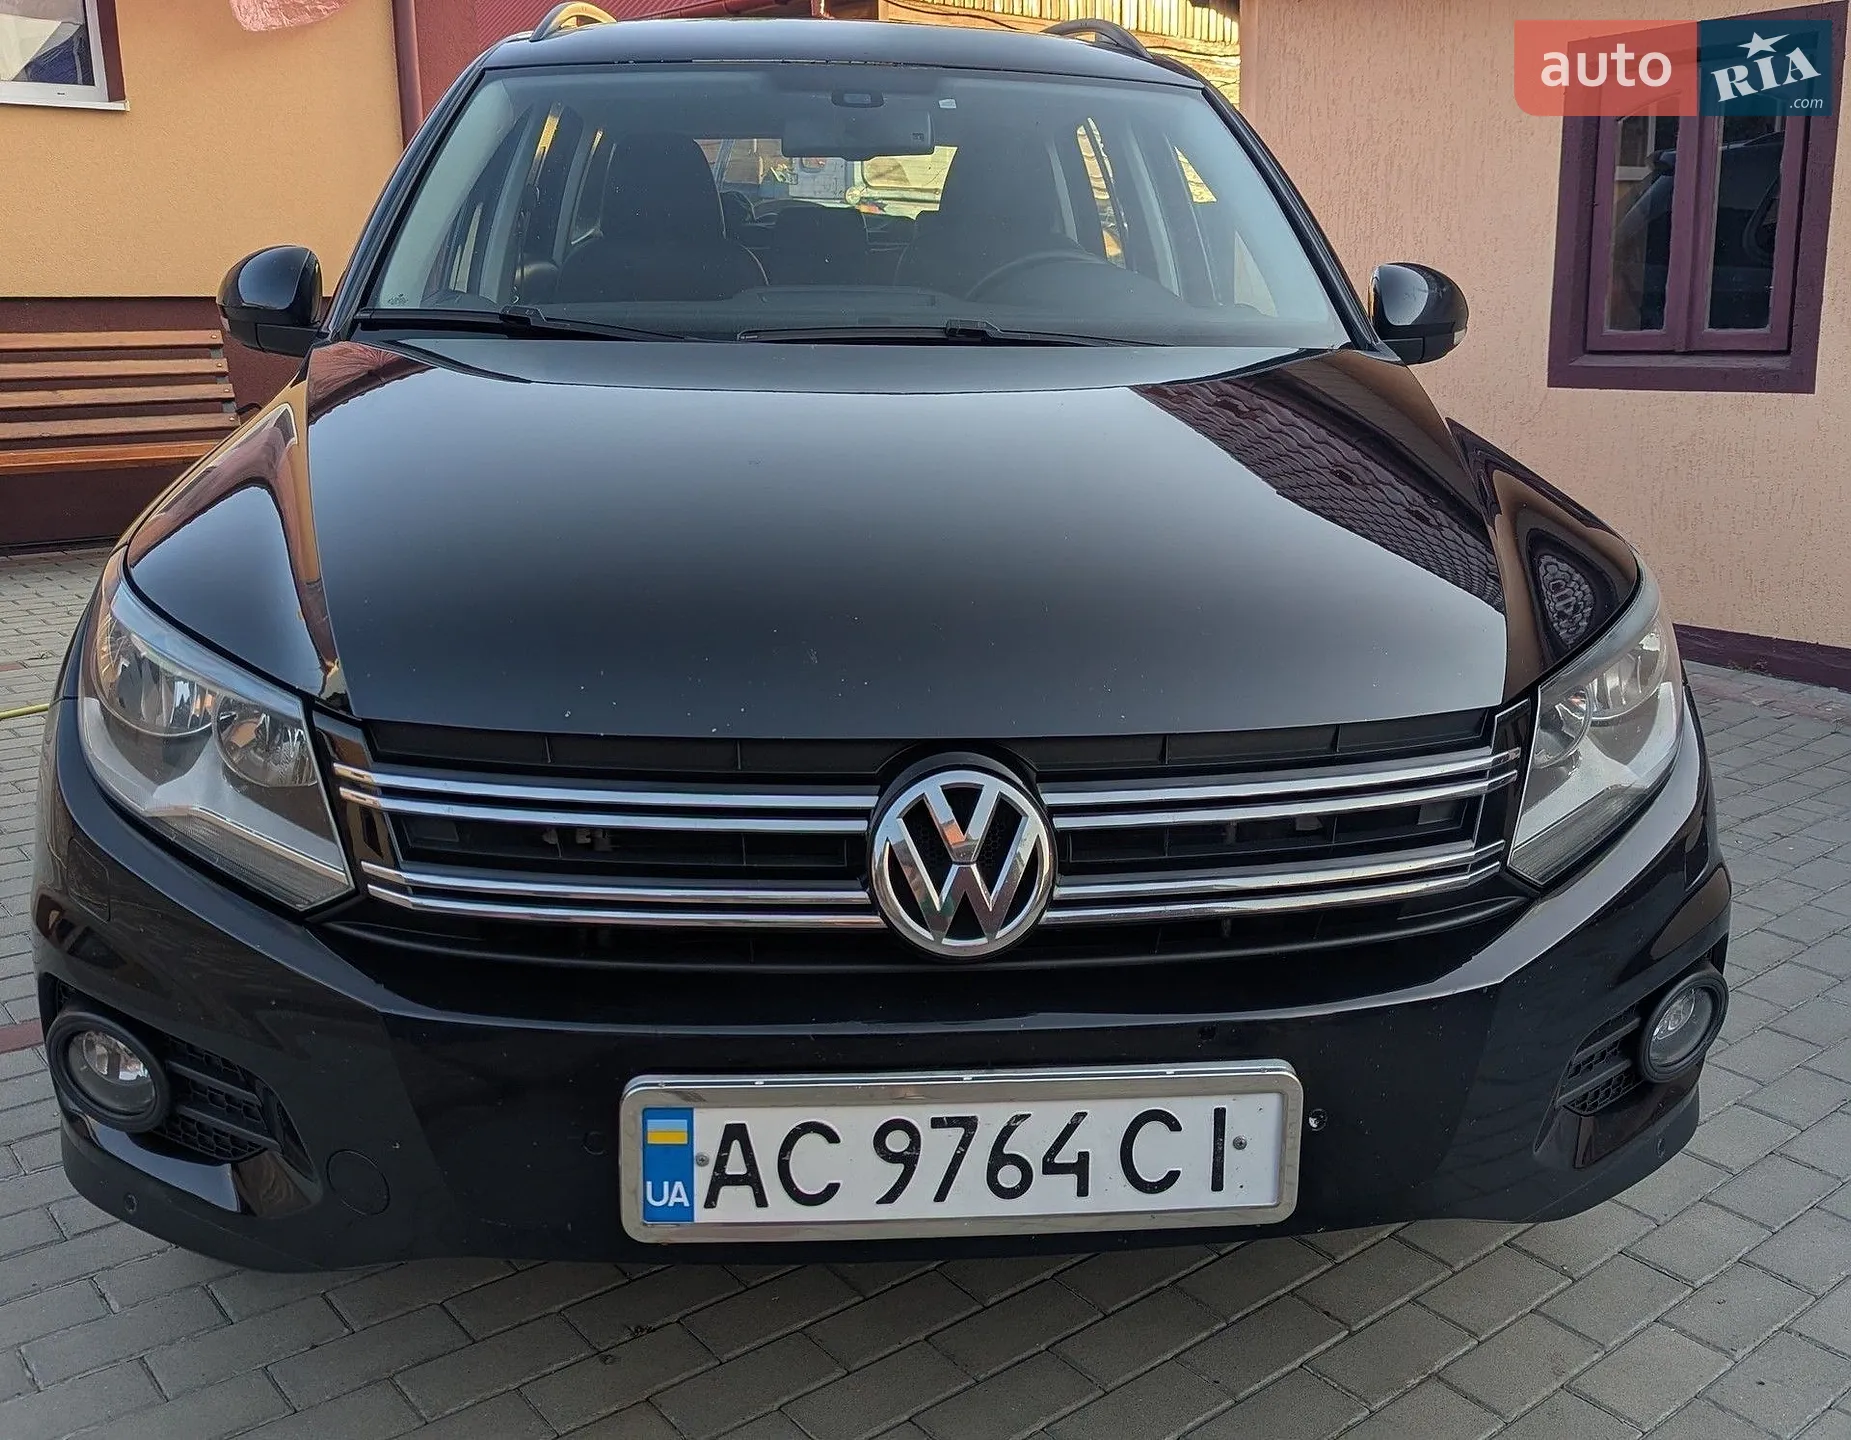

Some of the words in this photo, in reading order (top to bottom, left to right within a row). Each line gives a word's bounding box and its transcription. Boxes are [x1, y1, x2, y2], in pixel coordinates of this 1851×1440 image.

[704, 1121, 842, 1210] AC
[873, 1111, 1090, 1205] 9764
[646, 1180, 691, 1208] UA
